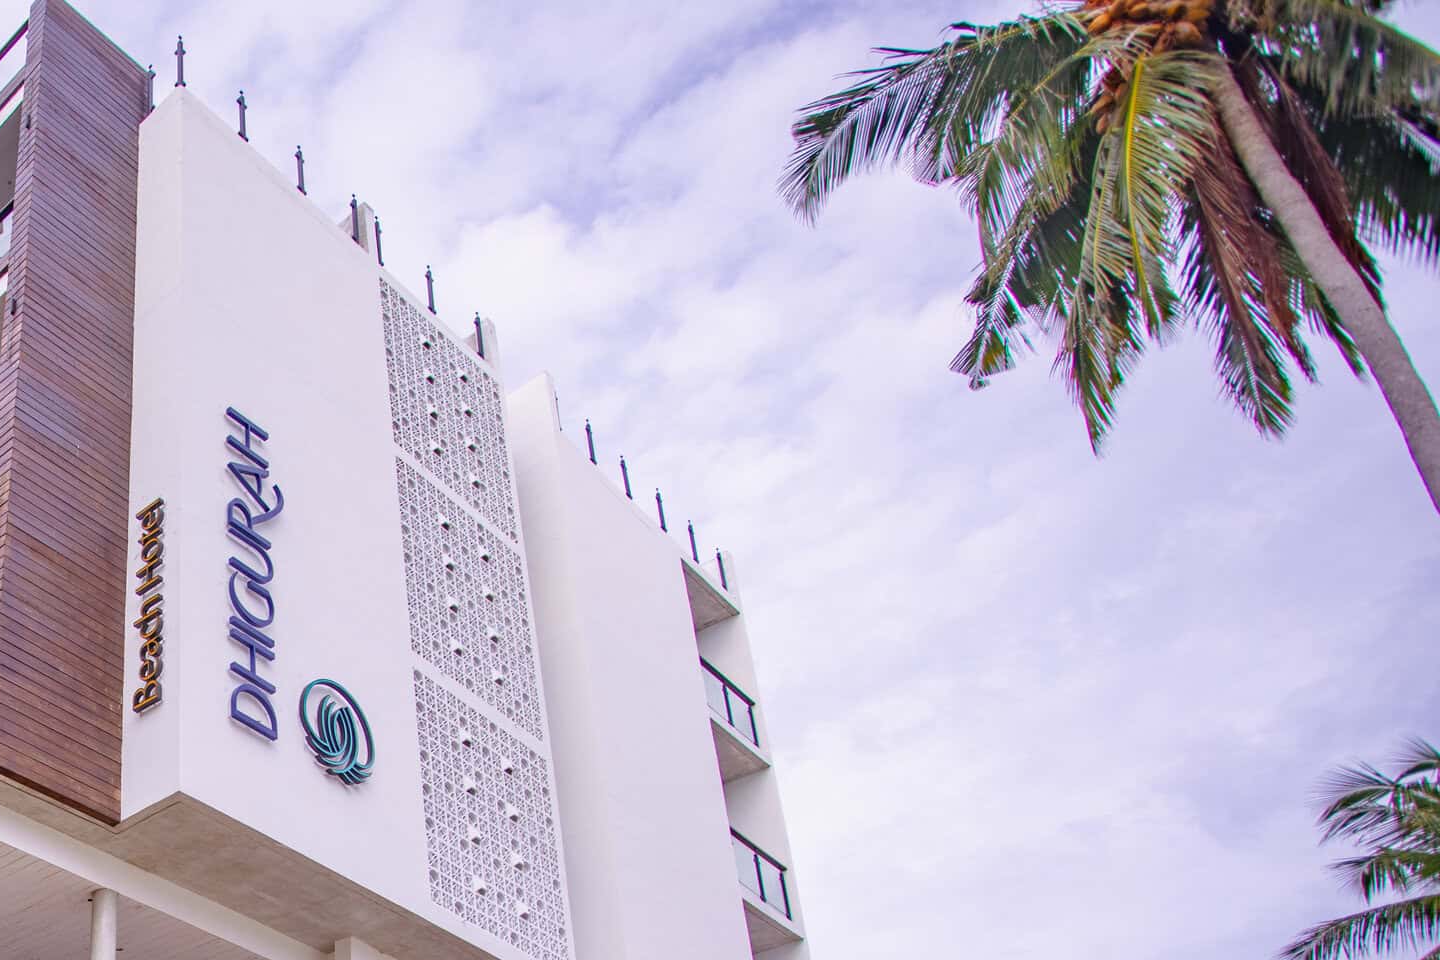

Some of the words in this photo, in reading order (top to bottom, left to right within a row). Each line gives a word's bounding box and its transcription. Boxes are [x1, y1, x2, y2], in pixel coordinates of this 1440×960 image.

[135, 497, 165, 597] Hotel
[224, 406, 284, 742] DHIGURAH
[133, 592, 165, 715] Beach
